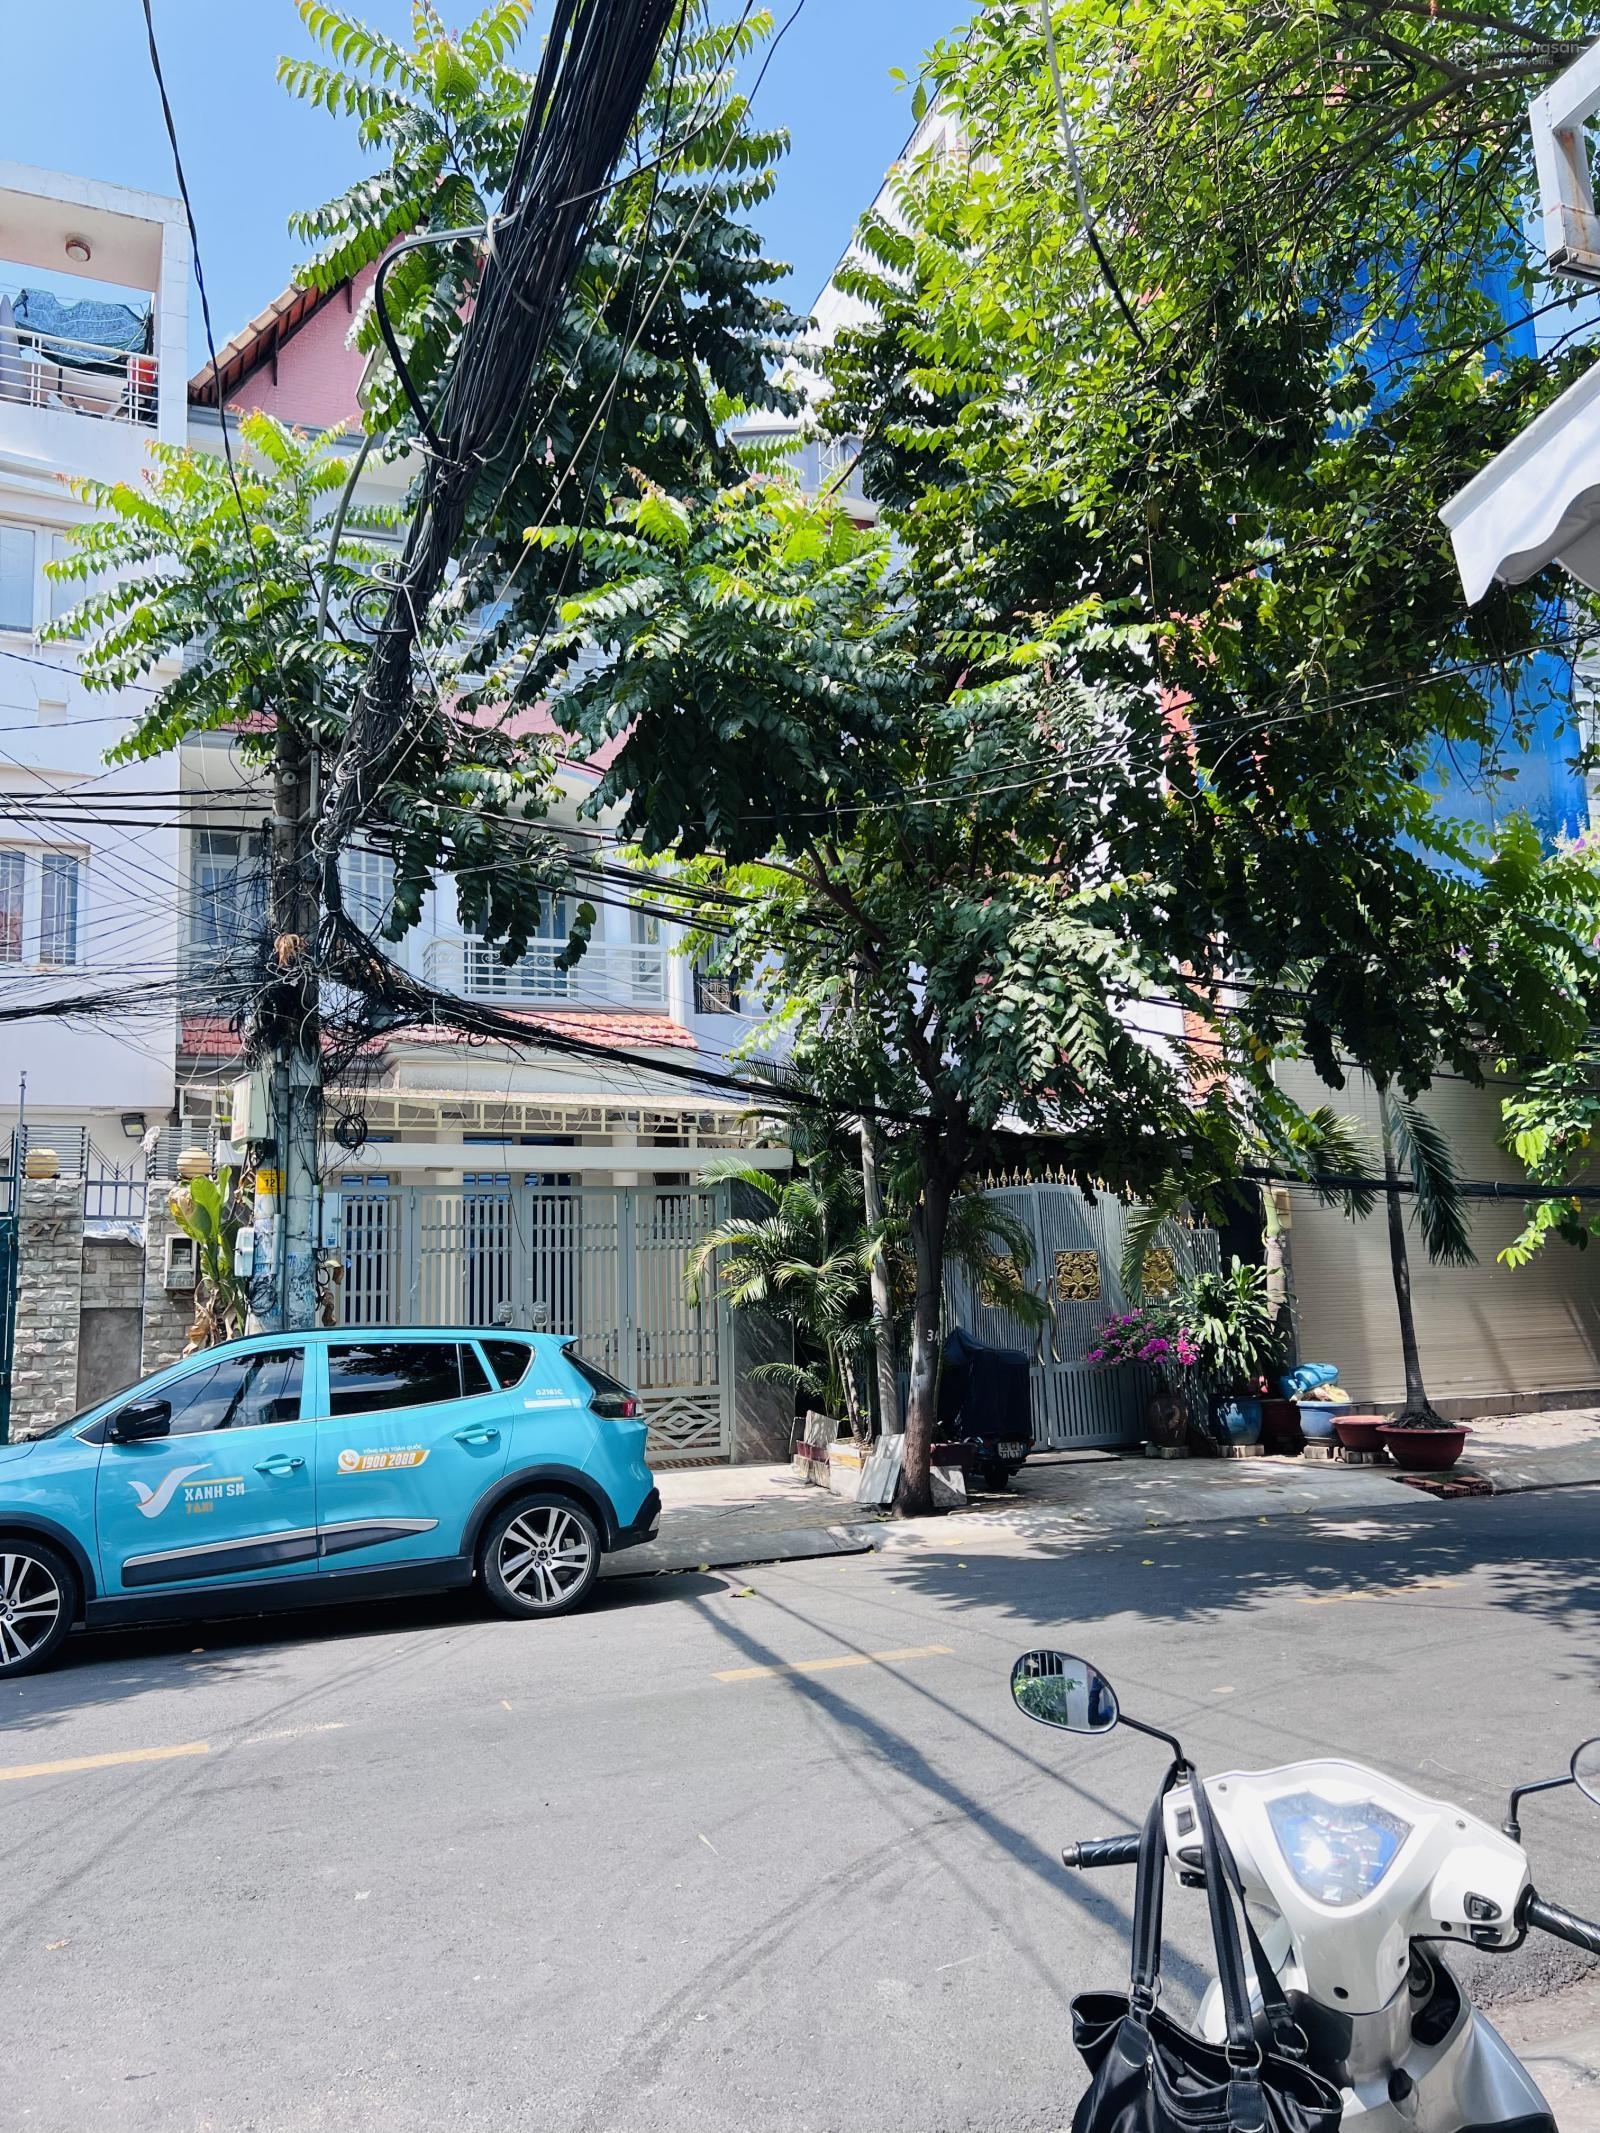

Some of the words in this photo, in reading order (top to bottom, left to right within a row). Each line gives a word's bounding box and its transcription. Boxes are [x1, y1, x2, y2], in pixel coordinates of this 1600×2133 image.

[28, 1219, 64, 1241] 27
[361, 1454, 387, 1469] 1900
[184, 1485, 223, 1501] XANH
[226, 1482, 245, 1497] SM
